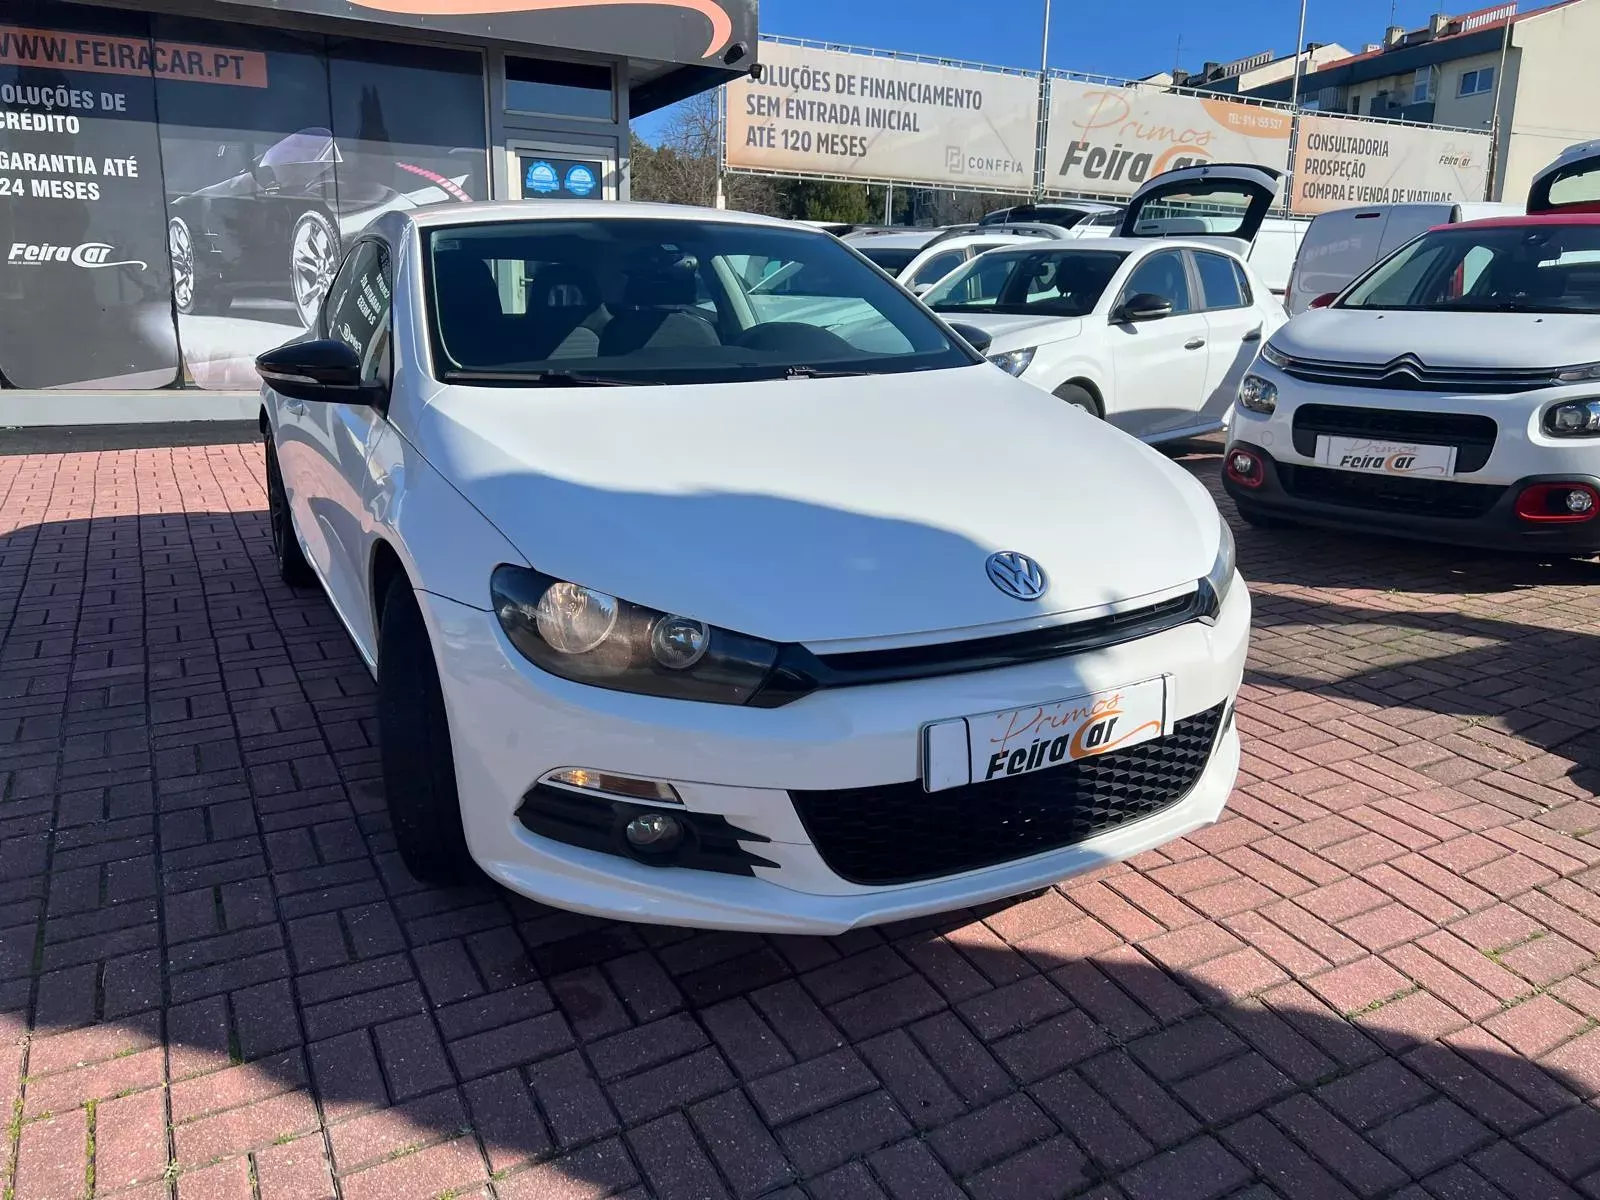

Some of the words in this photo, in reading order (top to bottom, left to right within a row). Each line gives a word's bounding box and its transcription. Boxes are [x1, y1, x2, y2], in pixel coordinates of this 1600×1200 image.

[746, 64, 831, 93] OLUÇÕES
[835, 73, 857, 96] DE
[860, 76, 983, 111] FINANCIAMENTO
[100, 92, 127, 112] DE
[746, 94, 781, 118] SEM
[785, 99, 861, 127] ENTRADA
[865, 107, 920, 133] INICIAL
[1072, 91, 1219, 149] Primos
[746, 123, 777, 149] ATÉ
[781, 129, 812, 153] 120
[816, 132, 867, 157] MESES
[1307, 133, 1389, 158] CONSULTADORIA
[0, 151, 98, 176] GARANTIA
[103, 155, 139, 178] ATÉ
[968, 156, 1024, 173] CONFFIA
[1304, 158, 1366, 181] PROSPEÇÃO
[0, 177, 25, 197] 24
[31, 179, 100, 201] MESES
[1302, 182, 1345, 201] COMPRA
[1348, 185, 1354, 201] E
[1357, 186, 1389, 204] VENDA
[1392, 188, 1405, 203] DE
[990, 691, 1125, 757] Primos
